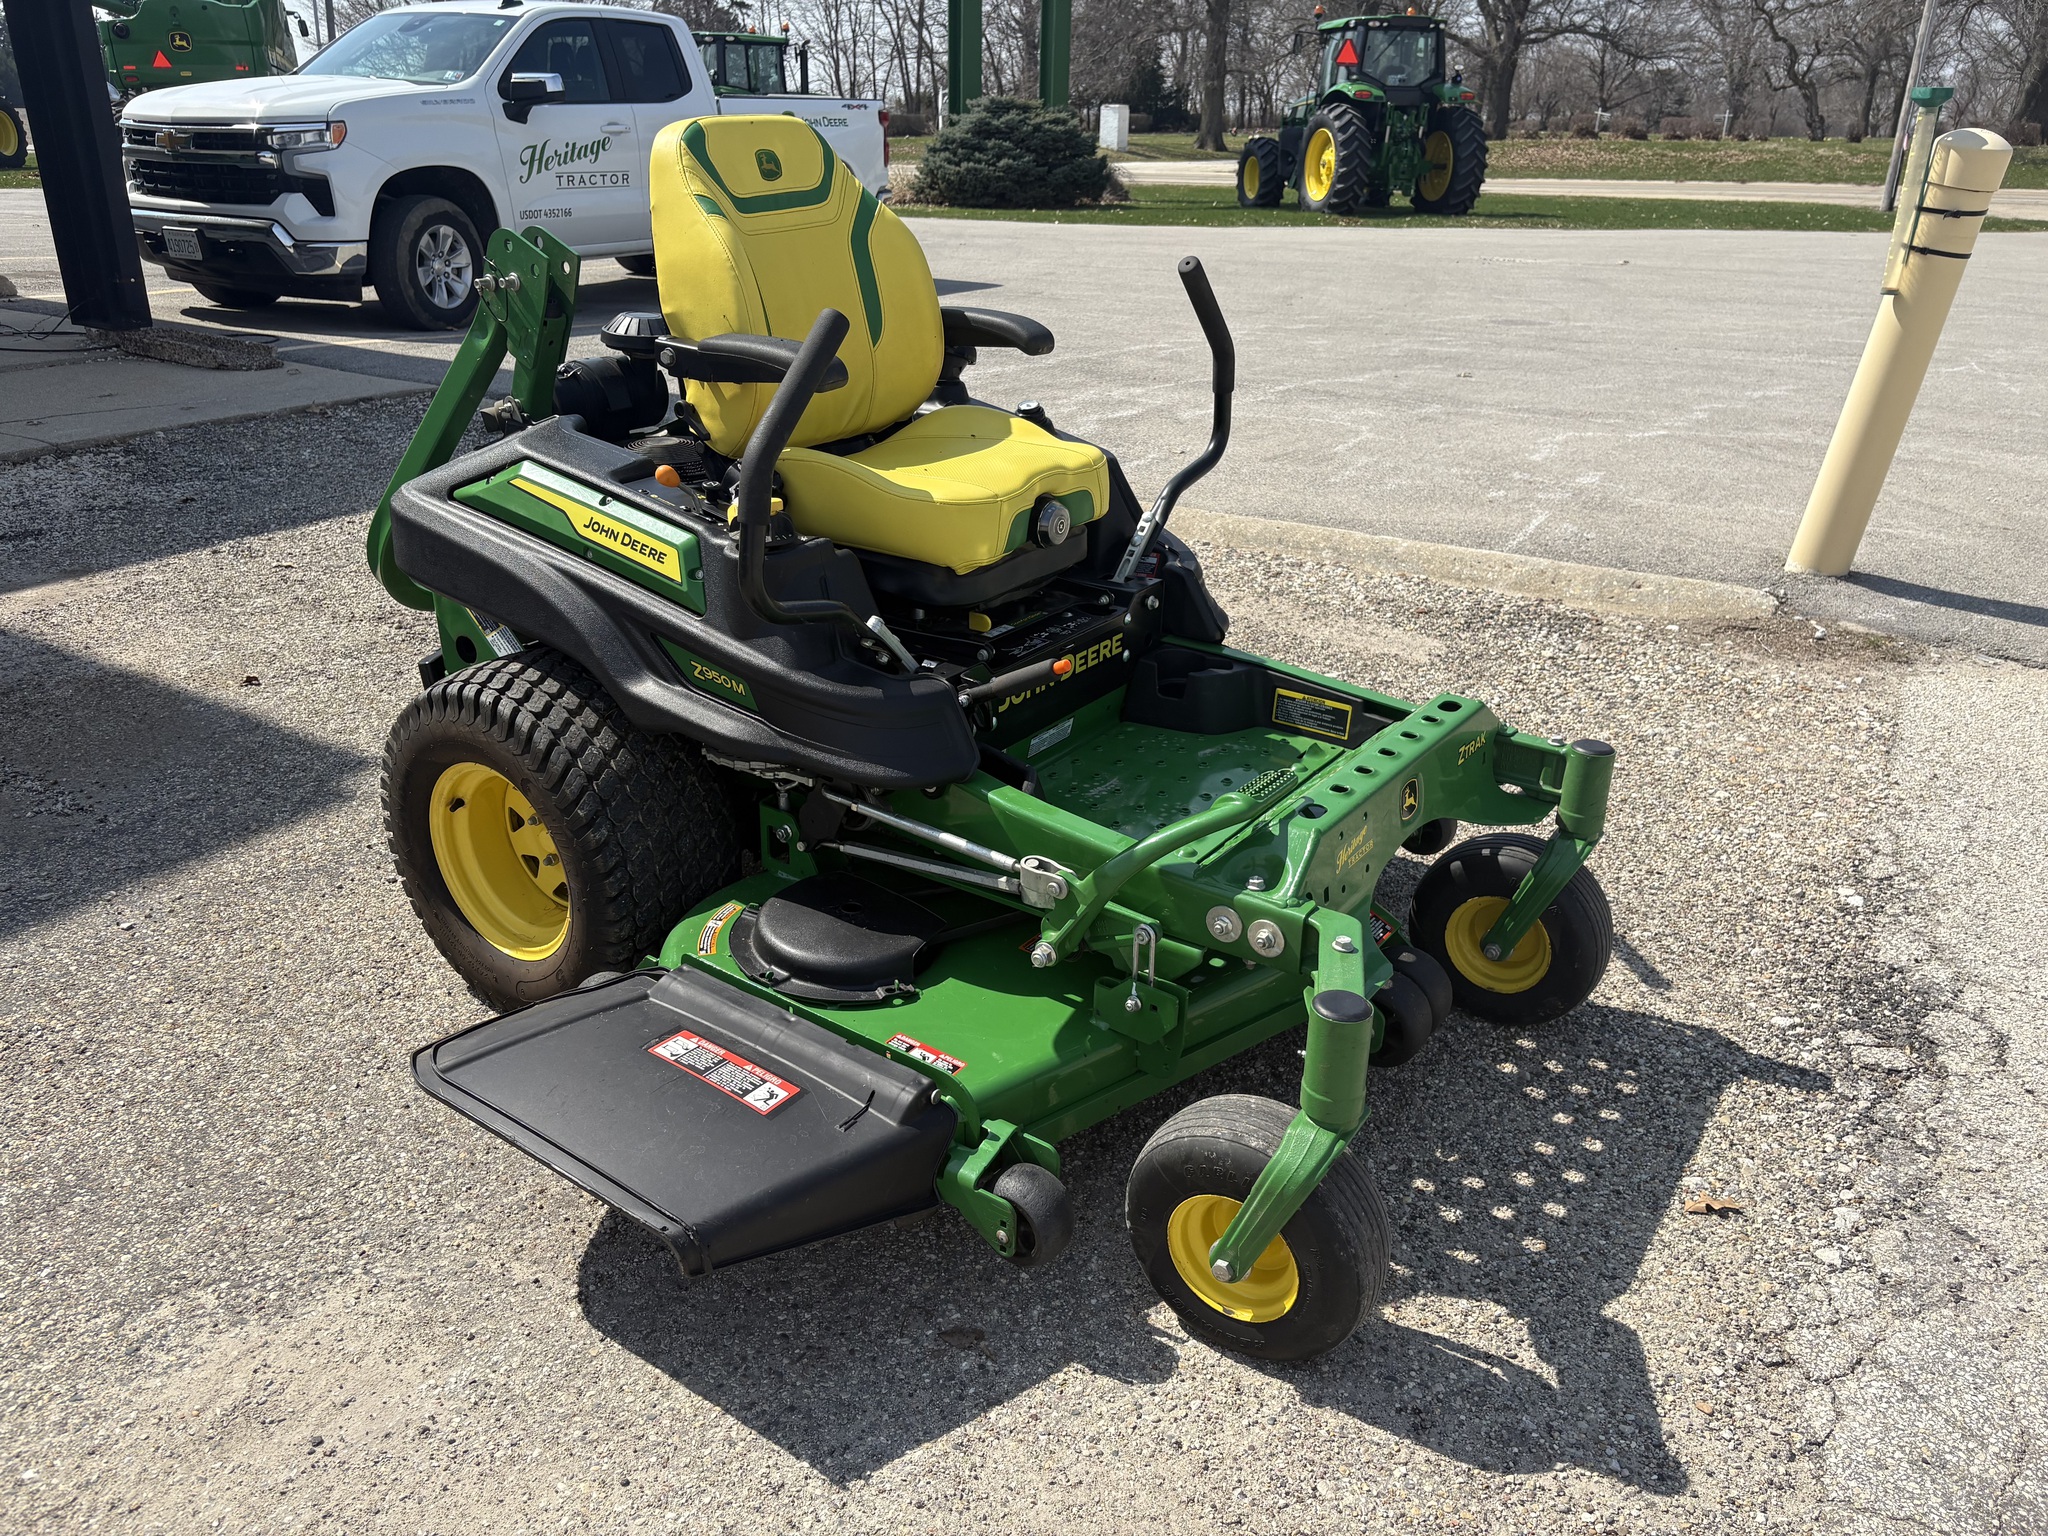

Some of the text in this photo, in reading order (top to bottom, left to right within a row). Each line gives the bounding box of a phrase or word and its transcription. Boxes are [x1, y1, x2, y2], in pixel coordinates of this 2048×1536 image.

[822, 116, 849, 127] DEERE
[519, 135, 613, 184] Heritage
[555, 173, 630, 187] TRACTOR
[519, 207, 573, 220] USDOT 4352166
[583, 516, 667, 565] JOHN DEERE
[1060, 632, 1124, 682] DEERE
[1457, 730, 1487, 766] ZTRAK
[699, 1039, 726, 1056] DANGER
[752, 1066, 782, 1086] PELIGRO
